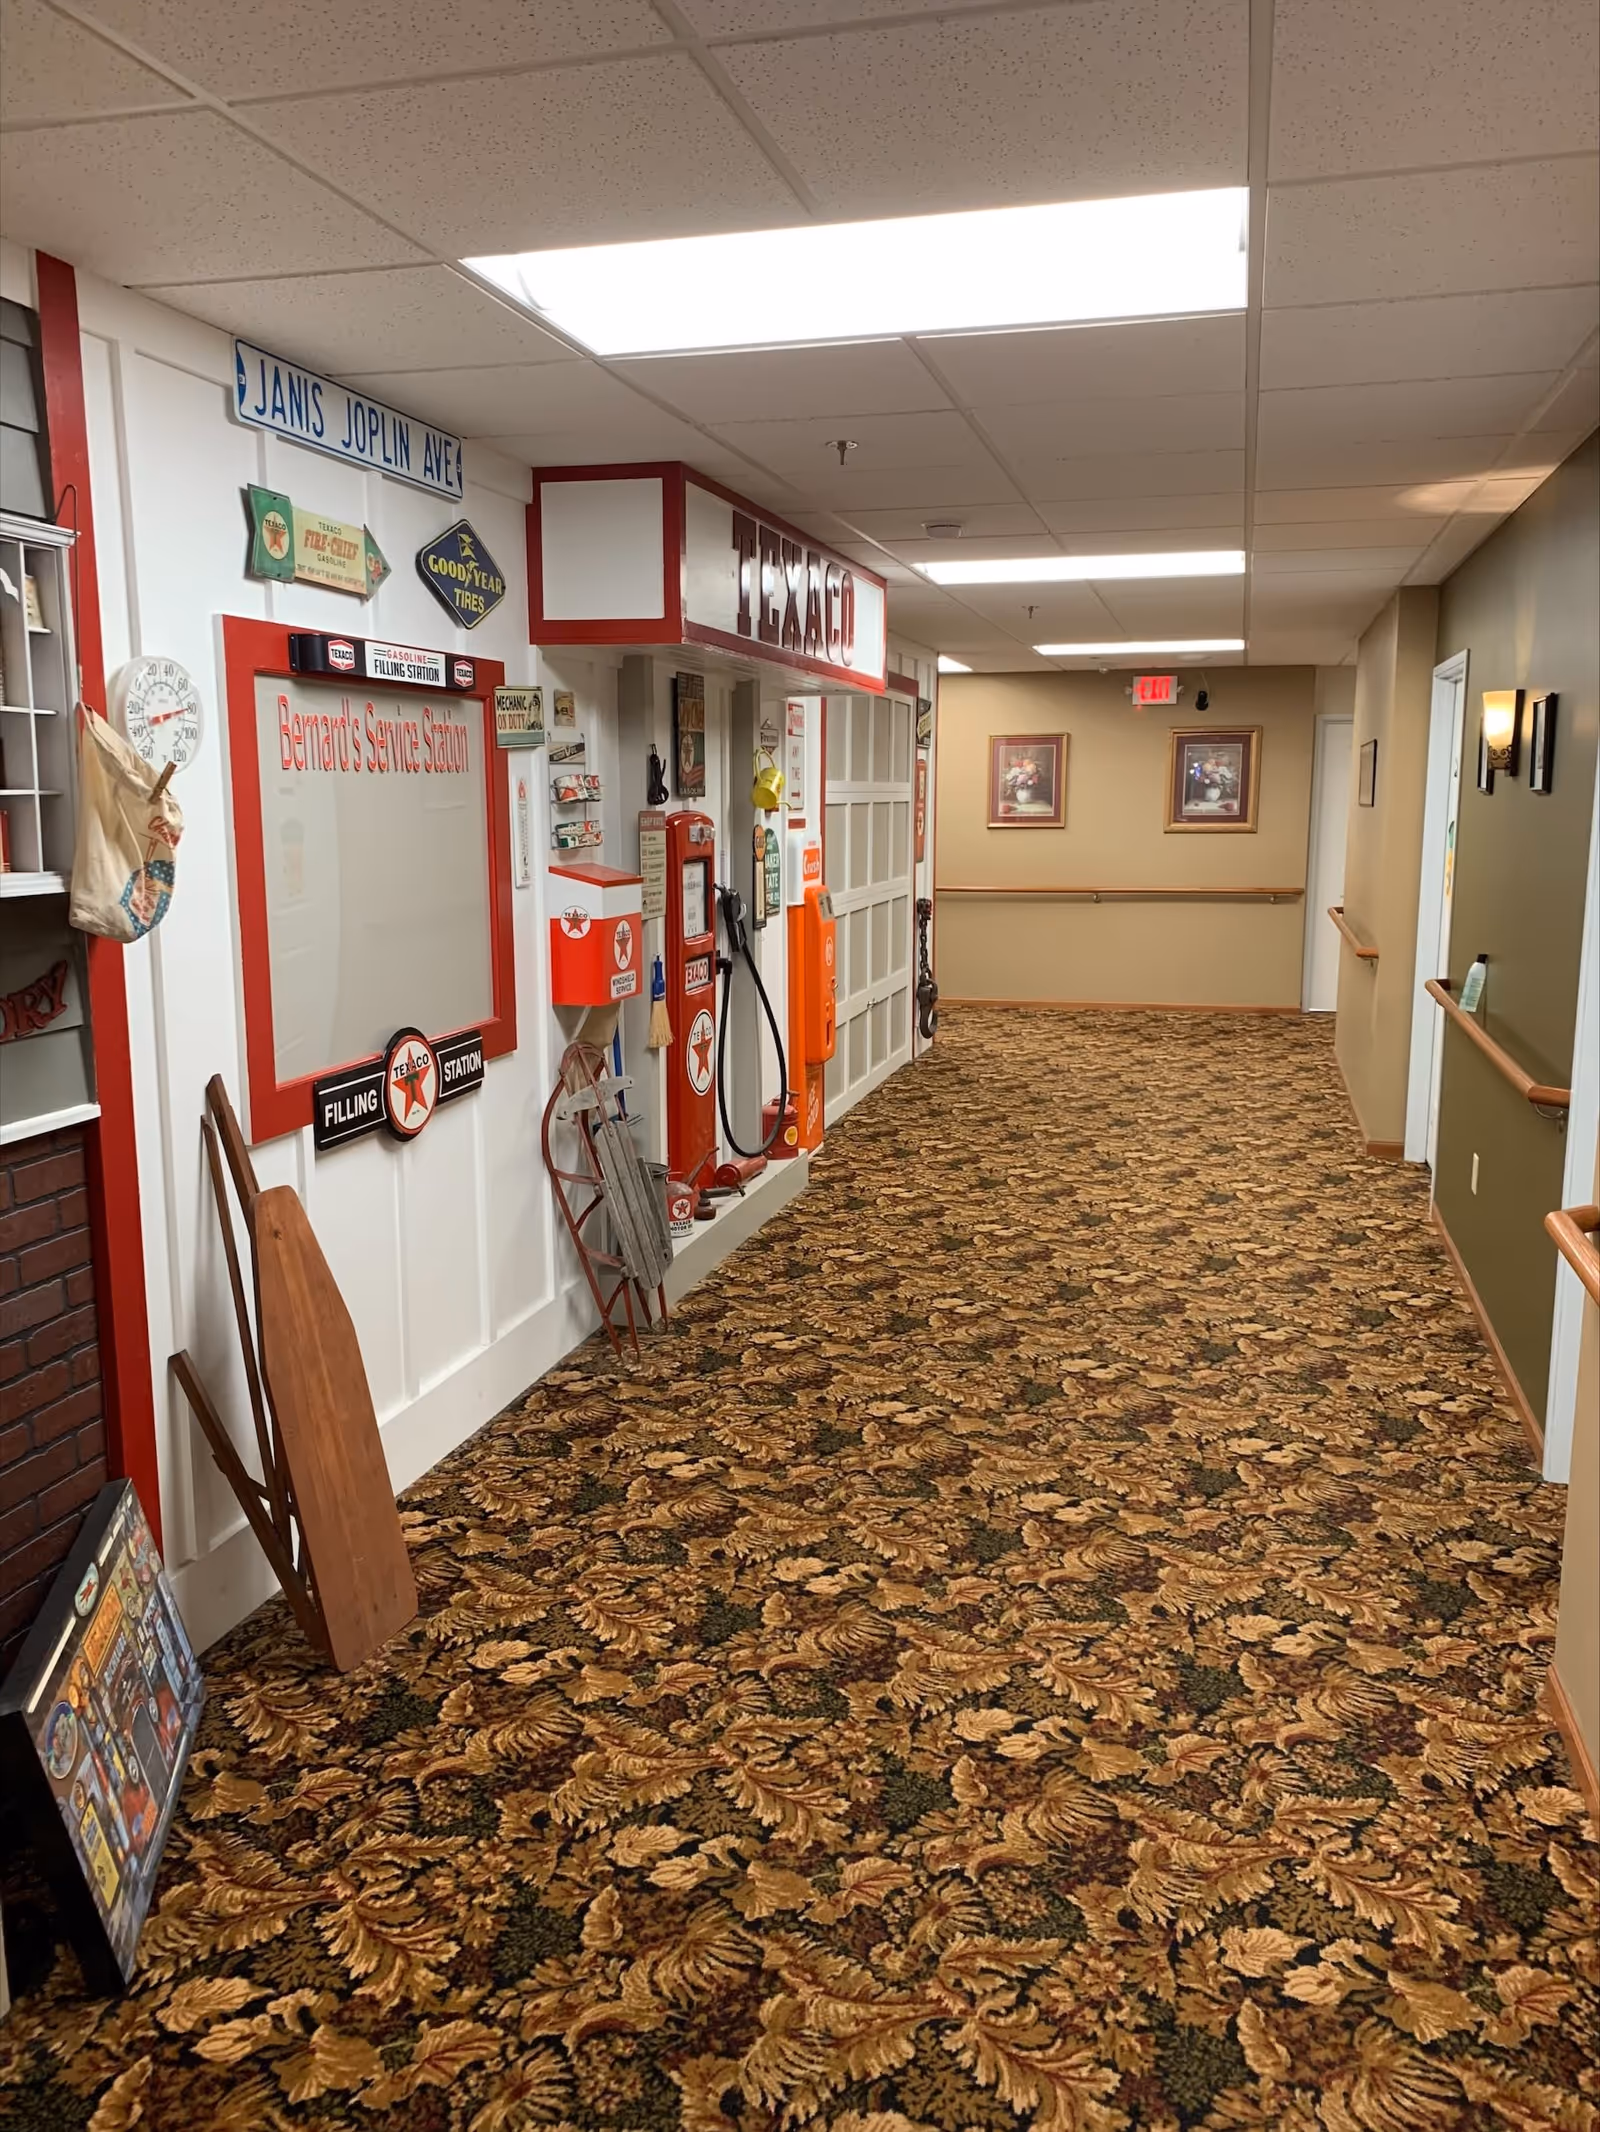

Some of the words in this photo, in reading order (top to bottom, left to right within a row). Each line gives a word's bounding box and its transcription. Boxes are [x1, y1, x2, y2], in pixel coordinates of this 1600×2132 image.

[255, 359, 324, 438] JANIS
[341, 397, 411, 471] JOPLIN
[423, 432, 454, 487] AVE
[264, 519, 287, 531] TEXACO
[318, 522, 342, 536] TEXACO
[317, 553, 347, 569] GASOLINE
[732, 509, 855, 667] TEXACO
[454, 587, 485, 614] TIRES
[331, 648, 354, 661] TEXACO
[386, 649, 428, 664] GASOLINE
[147, 663, 158, 676] 20
[163, 664, 174, 677] 40
[374, 659, 405, 678] FILLING
[407, 663, 440, 682] STATION
[456, 667, 473, 679] TEXACO
[177, 678, 189, 691] 60
[496, 695, 527, 711] MECHANIC
[497, 714, 507, 730] ON
[508, 714, 526, 730] DUTY
[184, 727, 197, 740] 100
[278, 694, 362, 772] Bernard's
[366, 701, 421, 773] Service
[422, 706, 469, 773] Station
[173, 749, 187, 762] 120
[804, 851, 820, 875] Crush
[766, 873, 779, 889] TATE
[612, 973, 635, 987] WINDSHIELD
[615, 983, 632, 995] SERVICE
[393, 1053, 429, 1079] TEXACO
[443, 1050, 482, 1082] STATION
[325, 1088, 378, 1128] FILLING
